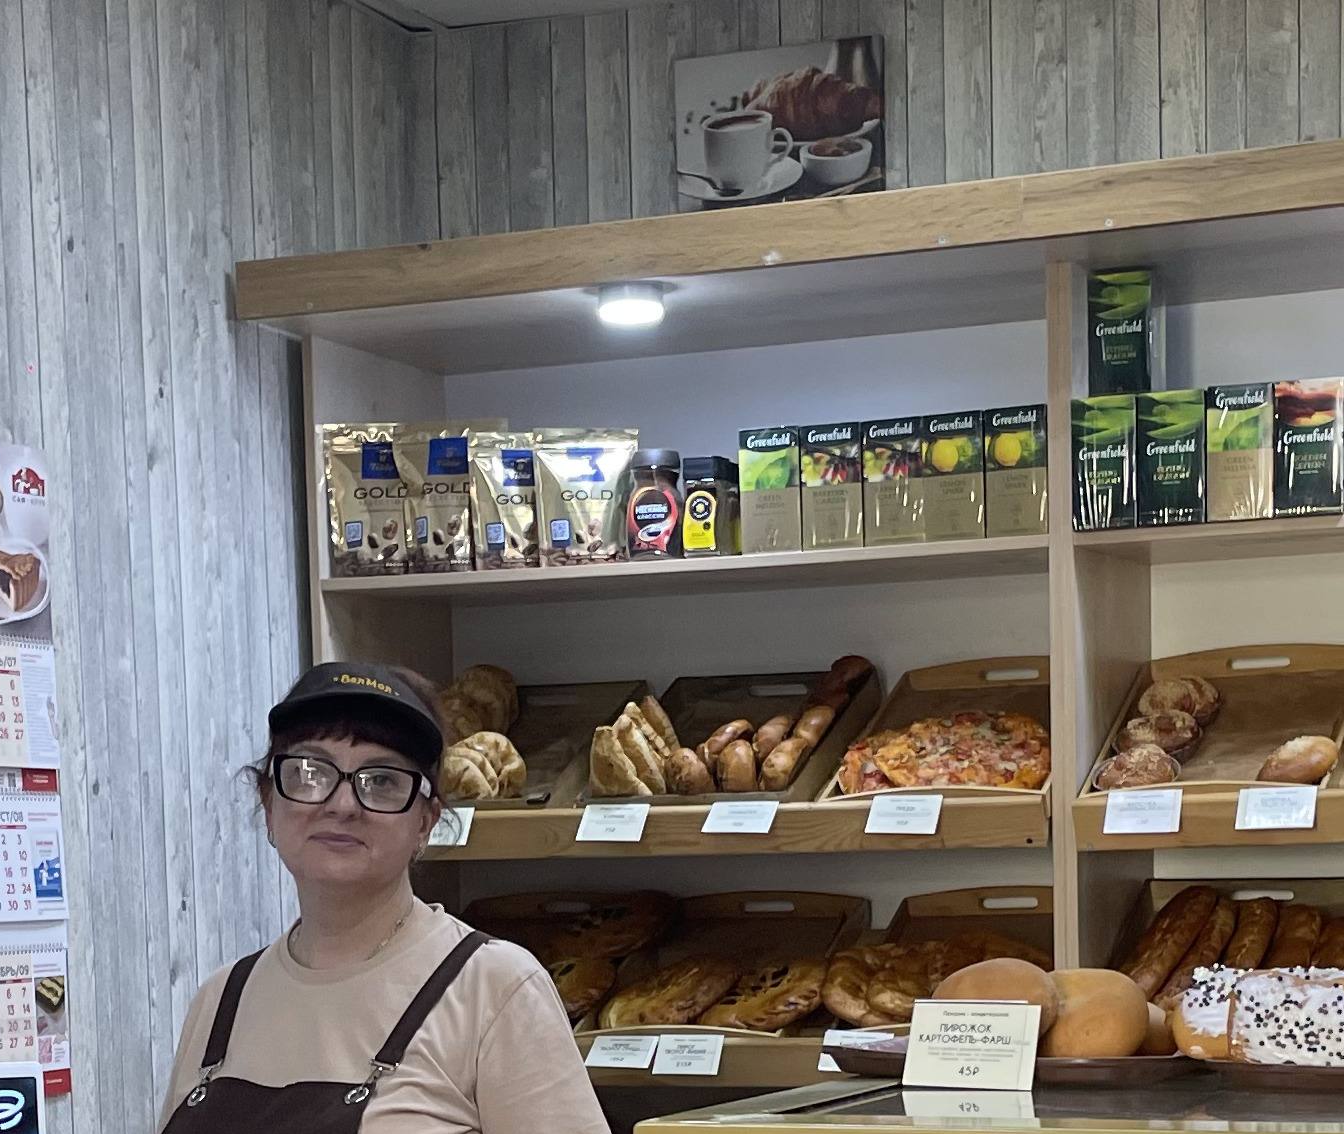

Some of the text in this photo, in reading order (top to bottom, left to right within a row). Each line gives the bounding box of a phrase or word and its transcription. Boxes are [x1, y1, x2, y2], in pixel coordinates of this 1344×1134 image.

[1096, 319, 1142, 337] Greenfield
[1216, 388, 1265, 408] Greenfield
[929, 416, 974, 433] Greenfield
[992, 410, 1037, 427] Greenfield
[807, 427, 852, 444] Greenfield
[868, 422, 913, 439] Greenfield
[1283, 428, 1335, 446] Greenfield
[746, 433, 791, 448] Greenfield
[1146, 439, 1196, 456] Greenfield
[1078, 444, 1128, 461] Greenfield
[353, 486, 408, 500] GOLD
[560, 489, 614, 502] GOLD
[6, 884, 15, 894] 23
[22, 884, 31, 894] 24
[8, 901, 18, 911] 30
[24, 900, 32, 910] 31
[939, 1023, 992, 1034] ПИРОЖОК
[918, 1033, 1012, 1046] КАРТОФЕЛЬ-ФАРШ
